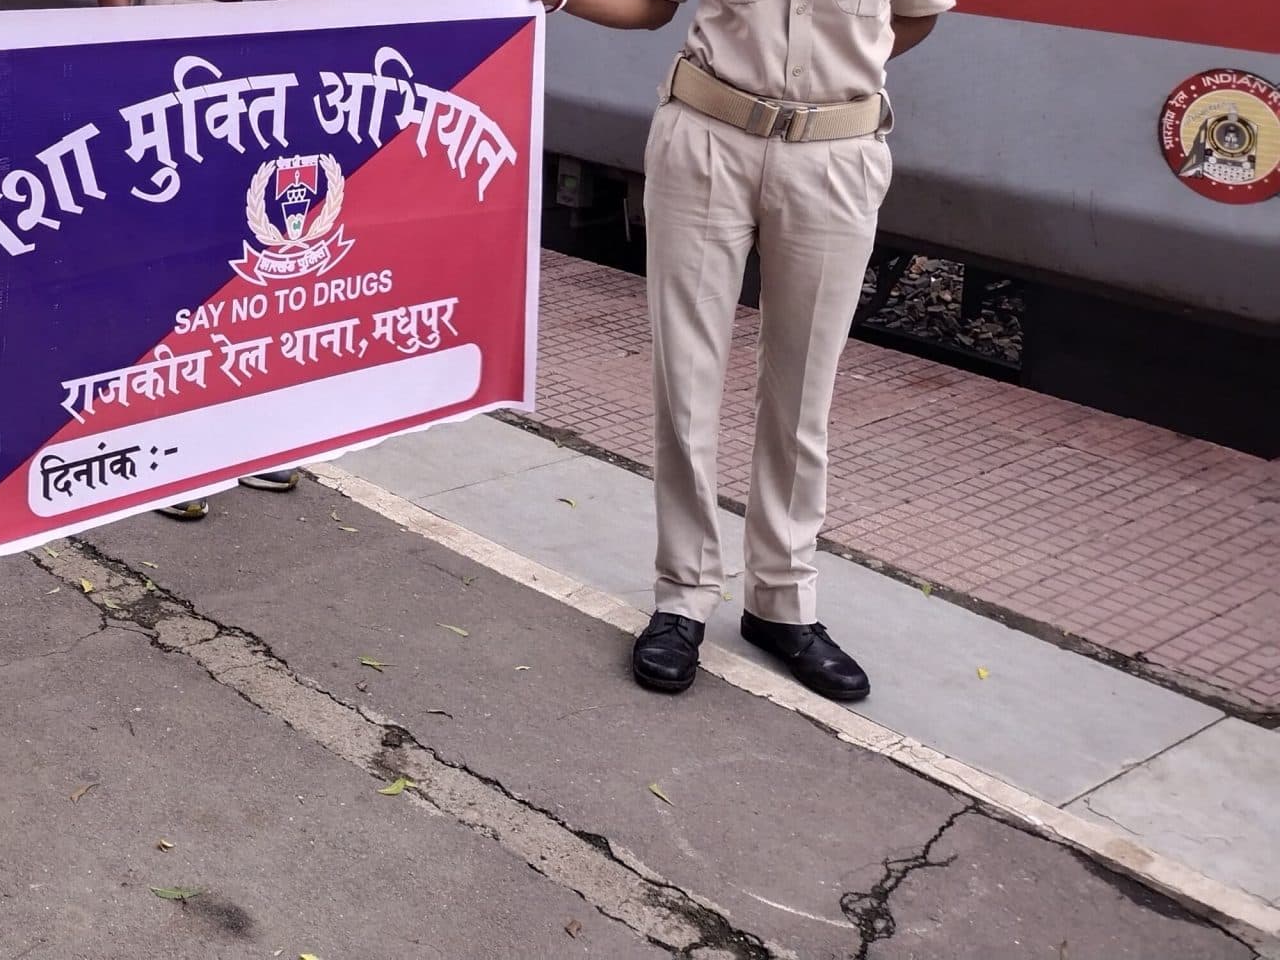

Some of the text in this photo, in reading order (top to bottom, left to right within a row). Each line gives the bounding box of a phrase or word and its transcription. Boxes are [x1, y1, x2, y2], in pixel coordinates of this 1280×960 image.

[1201, 73, 1267, 94] INDIAN
[119, 55, 299, 203] मुक्ति
[313, 46, 517, 202] अभियान
[174, 269, 394, 336] SAY NO TO DRUGS
[60, 296, 460, 424] राजकीय रेल थाना, मधुपुर
[40, 441, 143, 501] दिनांक
